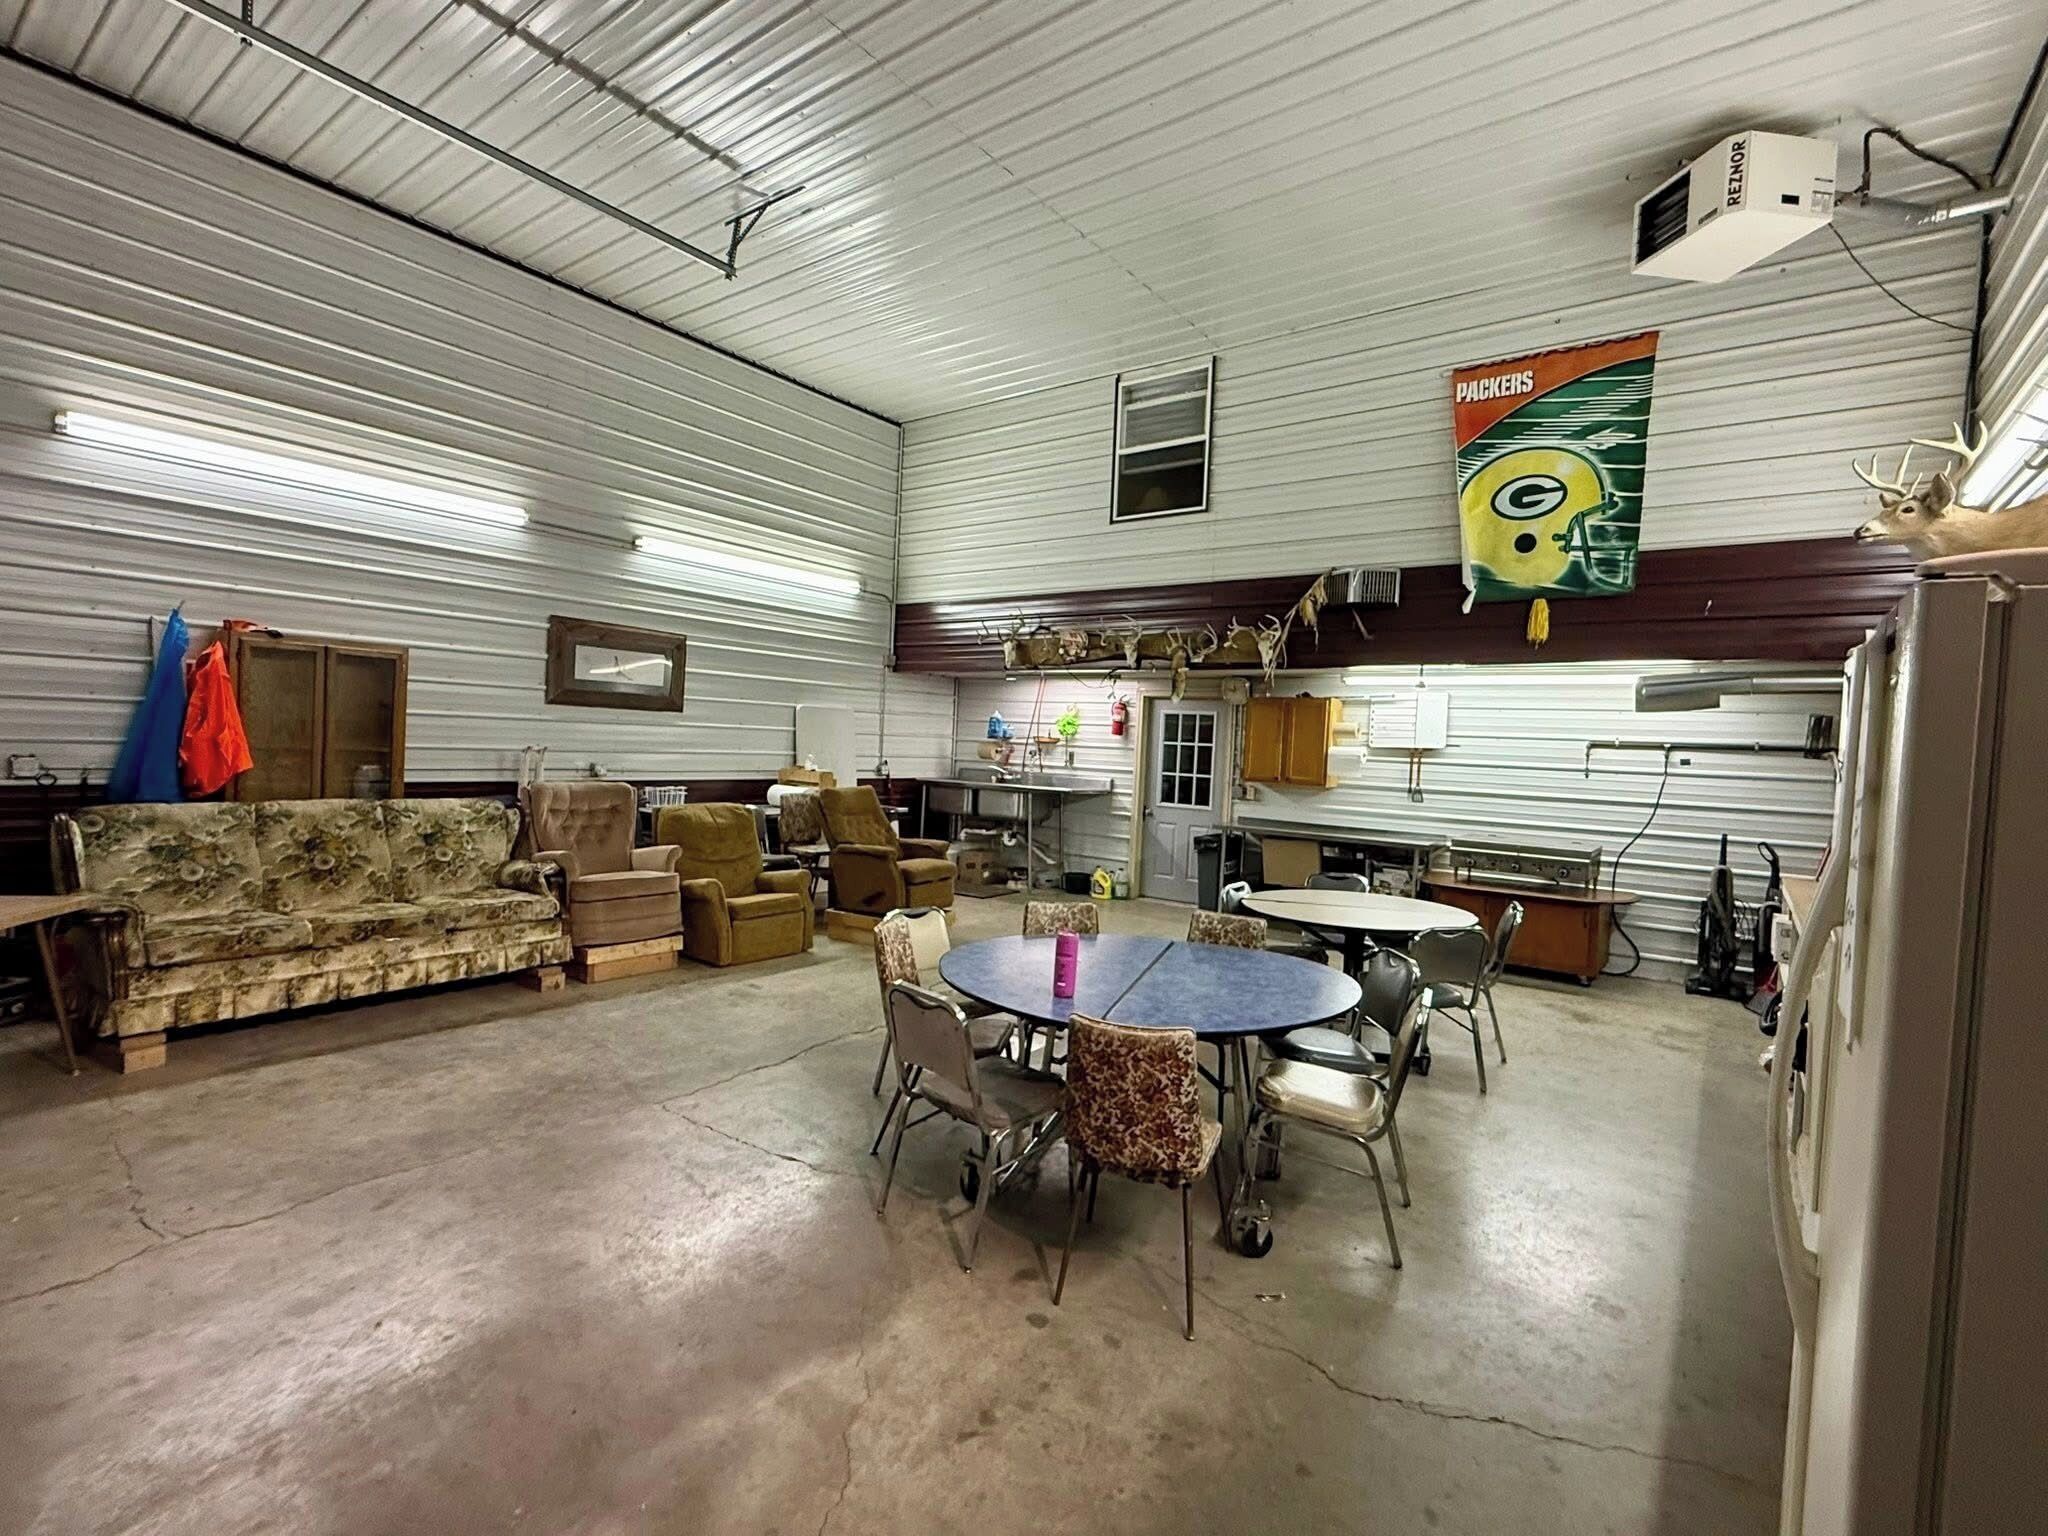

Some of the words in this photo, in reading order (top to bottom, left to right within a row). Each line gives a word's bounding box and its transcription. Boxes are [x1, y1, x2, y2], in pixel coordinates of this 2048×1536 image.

[1727, 139, 1746, 207] REZNOR
[1456, 370, 1534, 403] PACKERS
[1493, 475, 1566, 518] G
